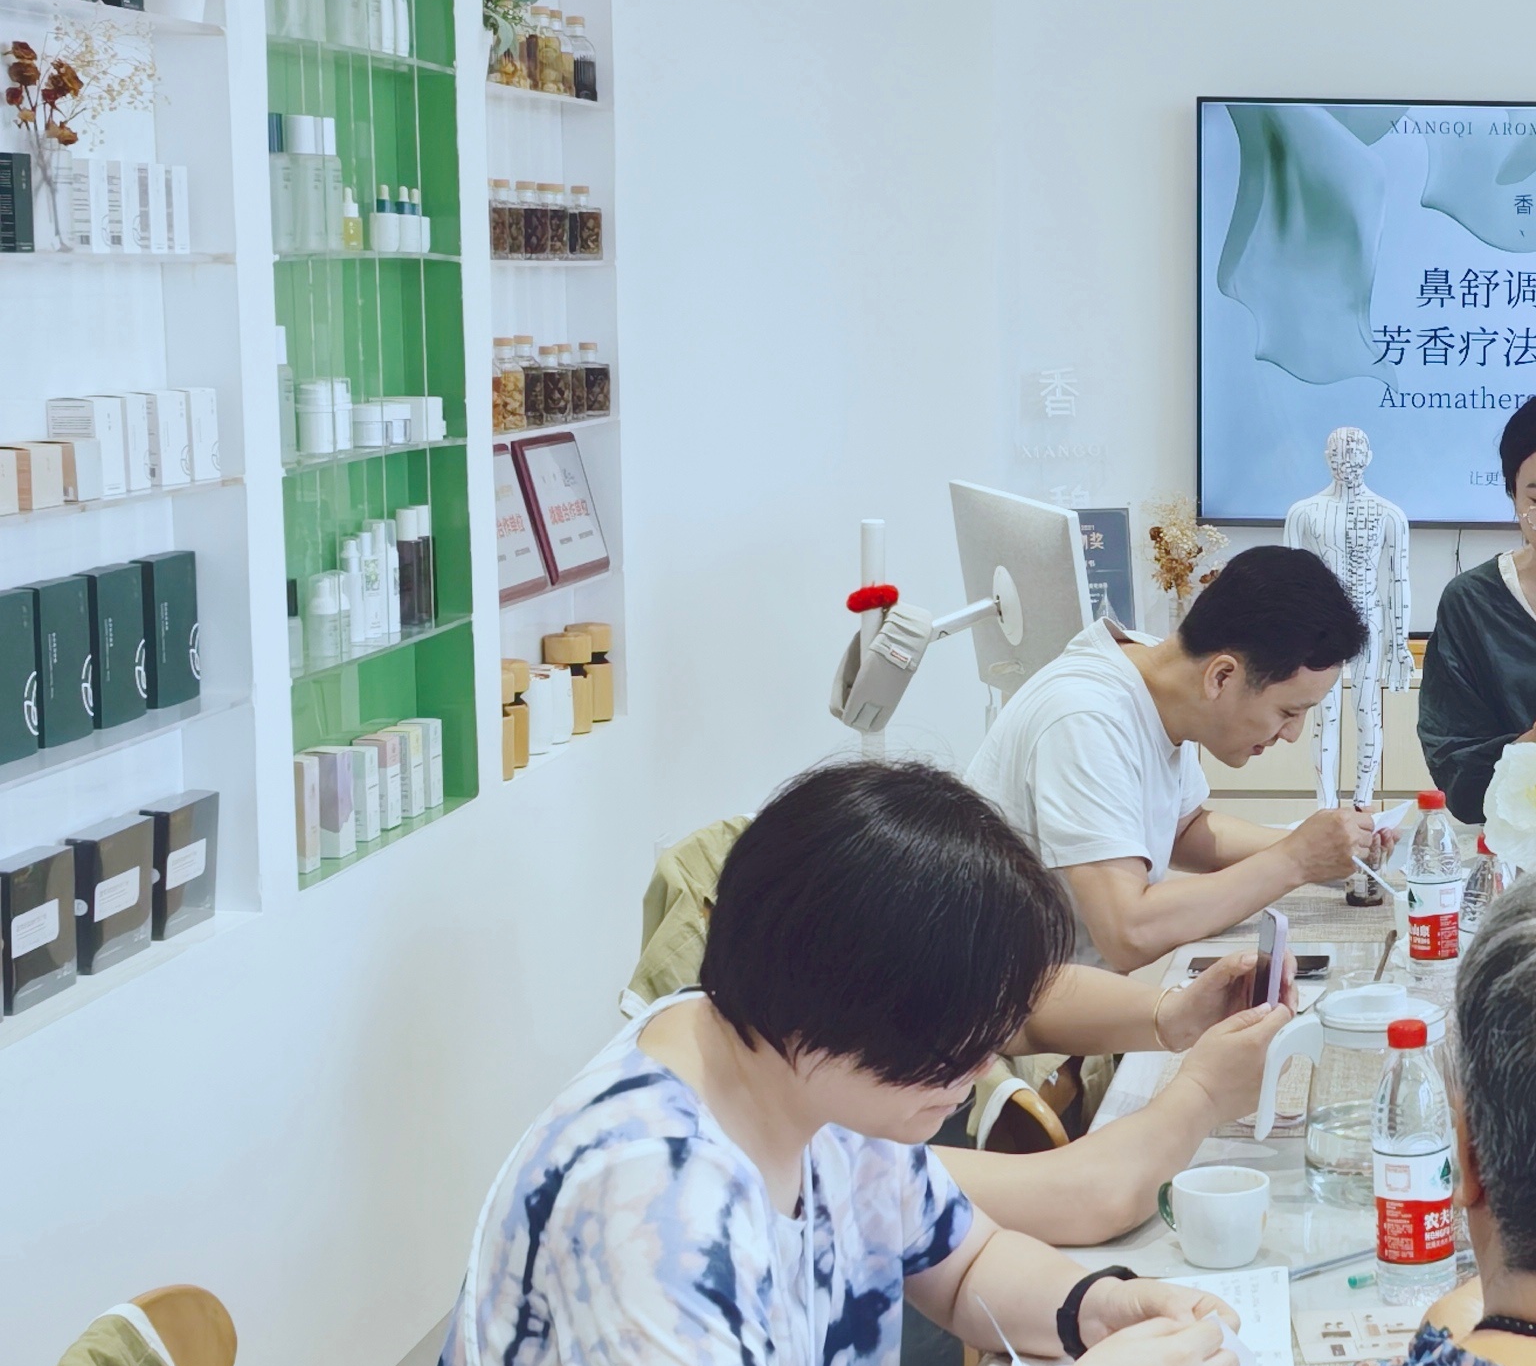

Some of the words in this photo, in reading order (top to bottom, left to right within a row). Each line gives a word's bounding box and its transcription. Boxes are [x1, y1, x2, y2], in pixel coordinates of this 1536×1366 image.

[1389, 120, 1473, 137] XIANGQI
[1514, 194, 1534, 215] 香
[1469, 470, 1506, 487] 让更
